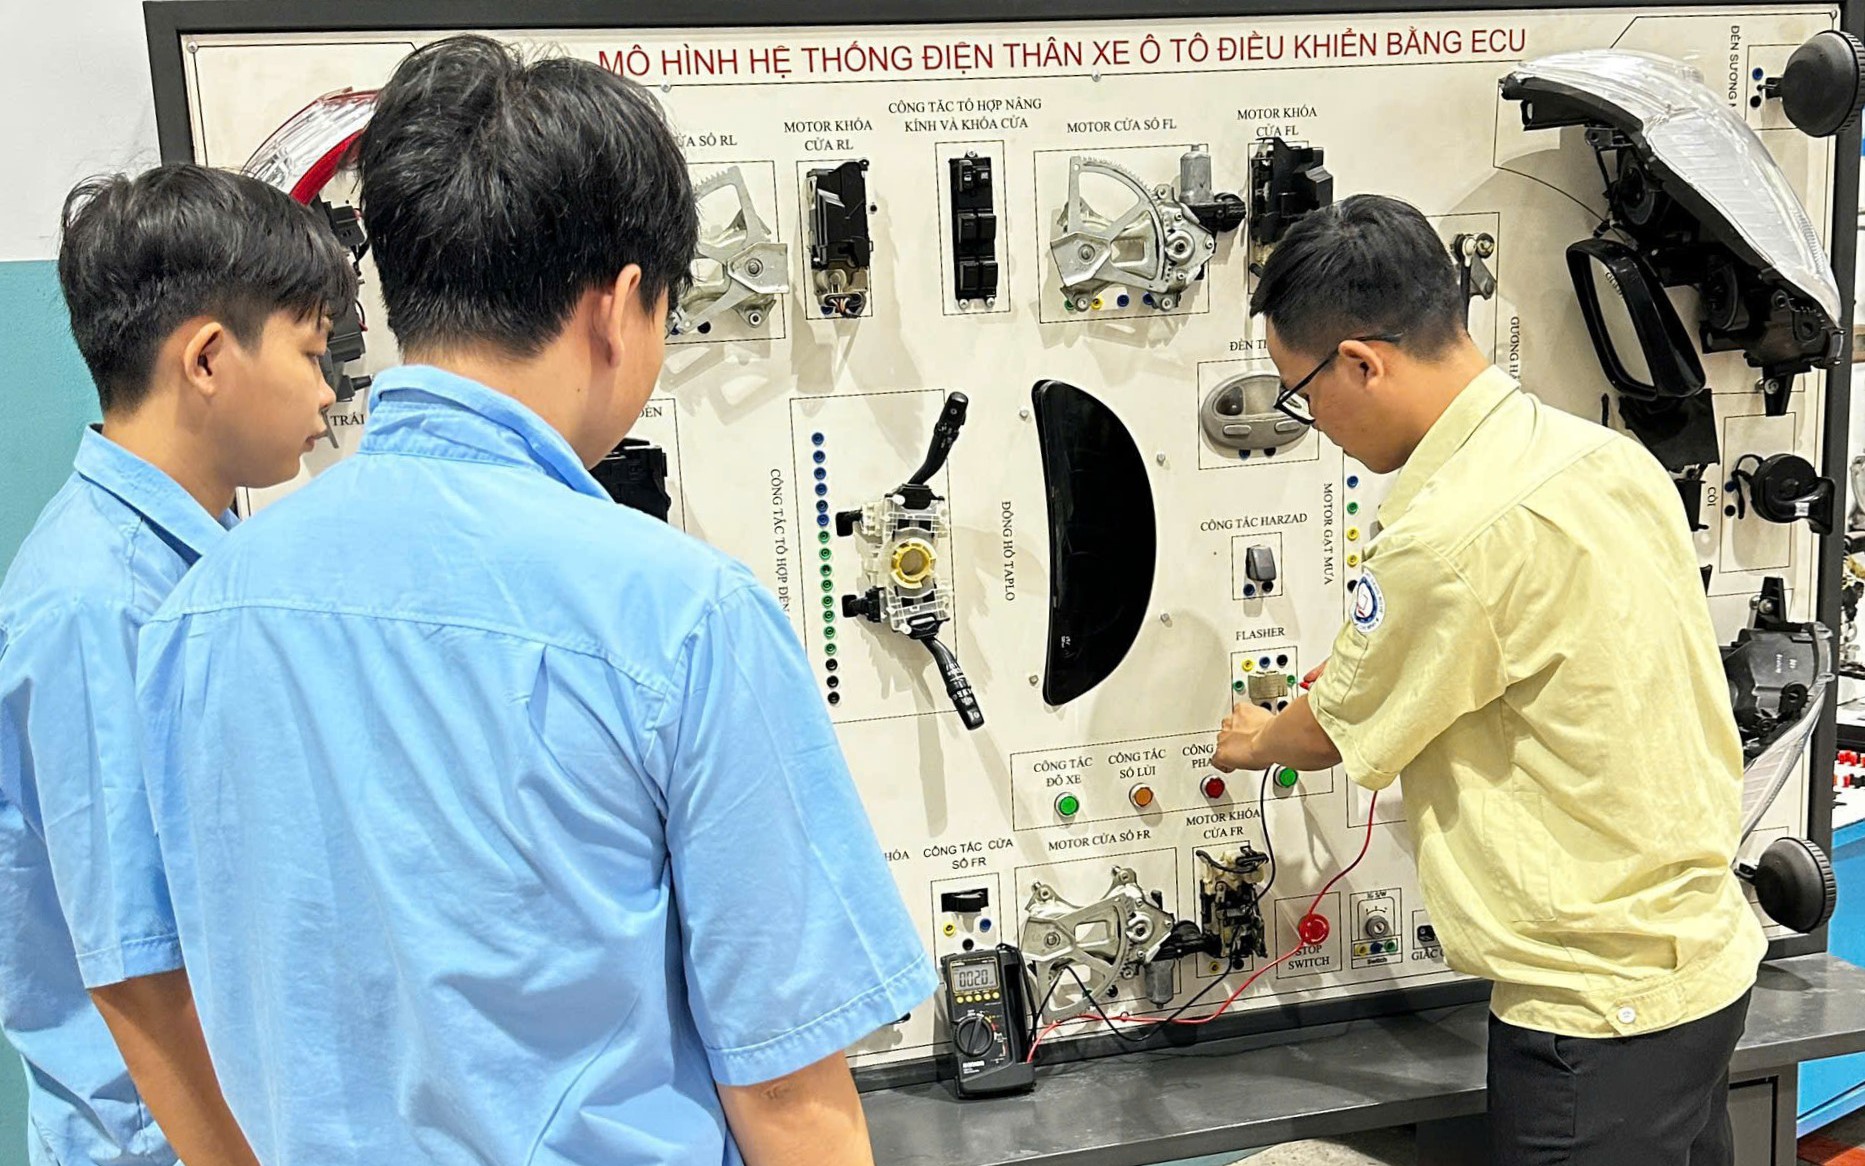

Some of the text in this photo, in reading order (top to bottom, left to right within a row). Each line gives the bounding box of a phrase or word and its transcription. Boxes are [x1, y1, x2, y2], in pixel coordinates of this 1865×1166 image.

[1730, 25, 1741, 51] ĐÈN
[598, 25, 1526, 79] MÔ HÌNH HỆ THỐNG ĐIỆN THÂN XE Ô TÔ ĐIỀU KHIỂN BẰNG ECU
[1728, 54, 1739, 105] SƯƠNG
[888, 98, 926, 114] CÔNG
[977, 99, 1003, 113] HỢP
[1005, 96, 1043, 111] NÂNG
[1236, 104, 1318, 121] MOTOR KHÓA
[783, 116, 873, 133] MOTOR KHÓA
[904, 114, 1029, 132] KÍNH VÀ KHÓA CỬA
[1066, 120, 1111, 134] MOTOR
[1113, 117, 1141, 132] CỬA
[1162, 118, 1177, 130] FL
[1255, 123, 1299, 138] CỬA FL
[672, 131, 697, 147] ỬA
[720, 134, 738, 147] RL
[804, 138, 854, 152] CỬA RL
[1229, 338, 1254, 352] ĐÈN
[1509, 316, 1520, 362] GƯƠNG
[330, 411, 365, 427] TRÁI
[770, 468, 784, 506] CÔNG
[1323, 482, 1333, 528] MOTOR
[1200, 518, 1233, 532] CÔNG
[1260, 512, 1308, 527] HARZAD
[775, 557, 789, 584] HỢP
[1323, 556, 1334, 586] MƯA
[1004, 560, 1015, 602] TAPLO
[1235, 626, 1286, 641] FLASHER
[1108, 751, 1141, 765] CÔNG
[1182, 743, 1214, 757] CÔNG
[1033, 759, 1067, 773] CÔNG
[1137, 764, 1156, 777] LÙI
[1191, 758, 1213, 769] PHA
[1065, 774, 1082, 786] XE
[1186, 806, 1261, 827] MOTOR KHÓA
[1203, 825, 1244, 839] CỬA FR
[923, 845, 958, 858] CÔNG
[988, 837, 1014, 850] CỬA
[1048, 837, 1090, 852] MOTOR
[1092, 832, 1117, 846] CỬA
[883, 848, 910, 862] HÓA
[970, 856, 987, 868] FR
[1294, 944, 1323, 957] STOP
[1288, 956, 1330, 970] SWITCH
